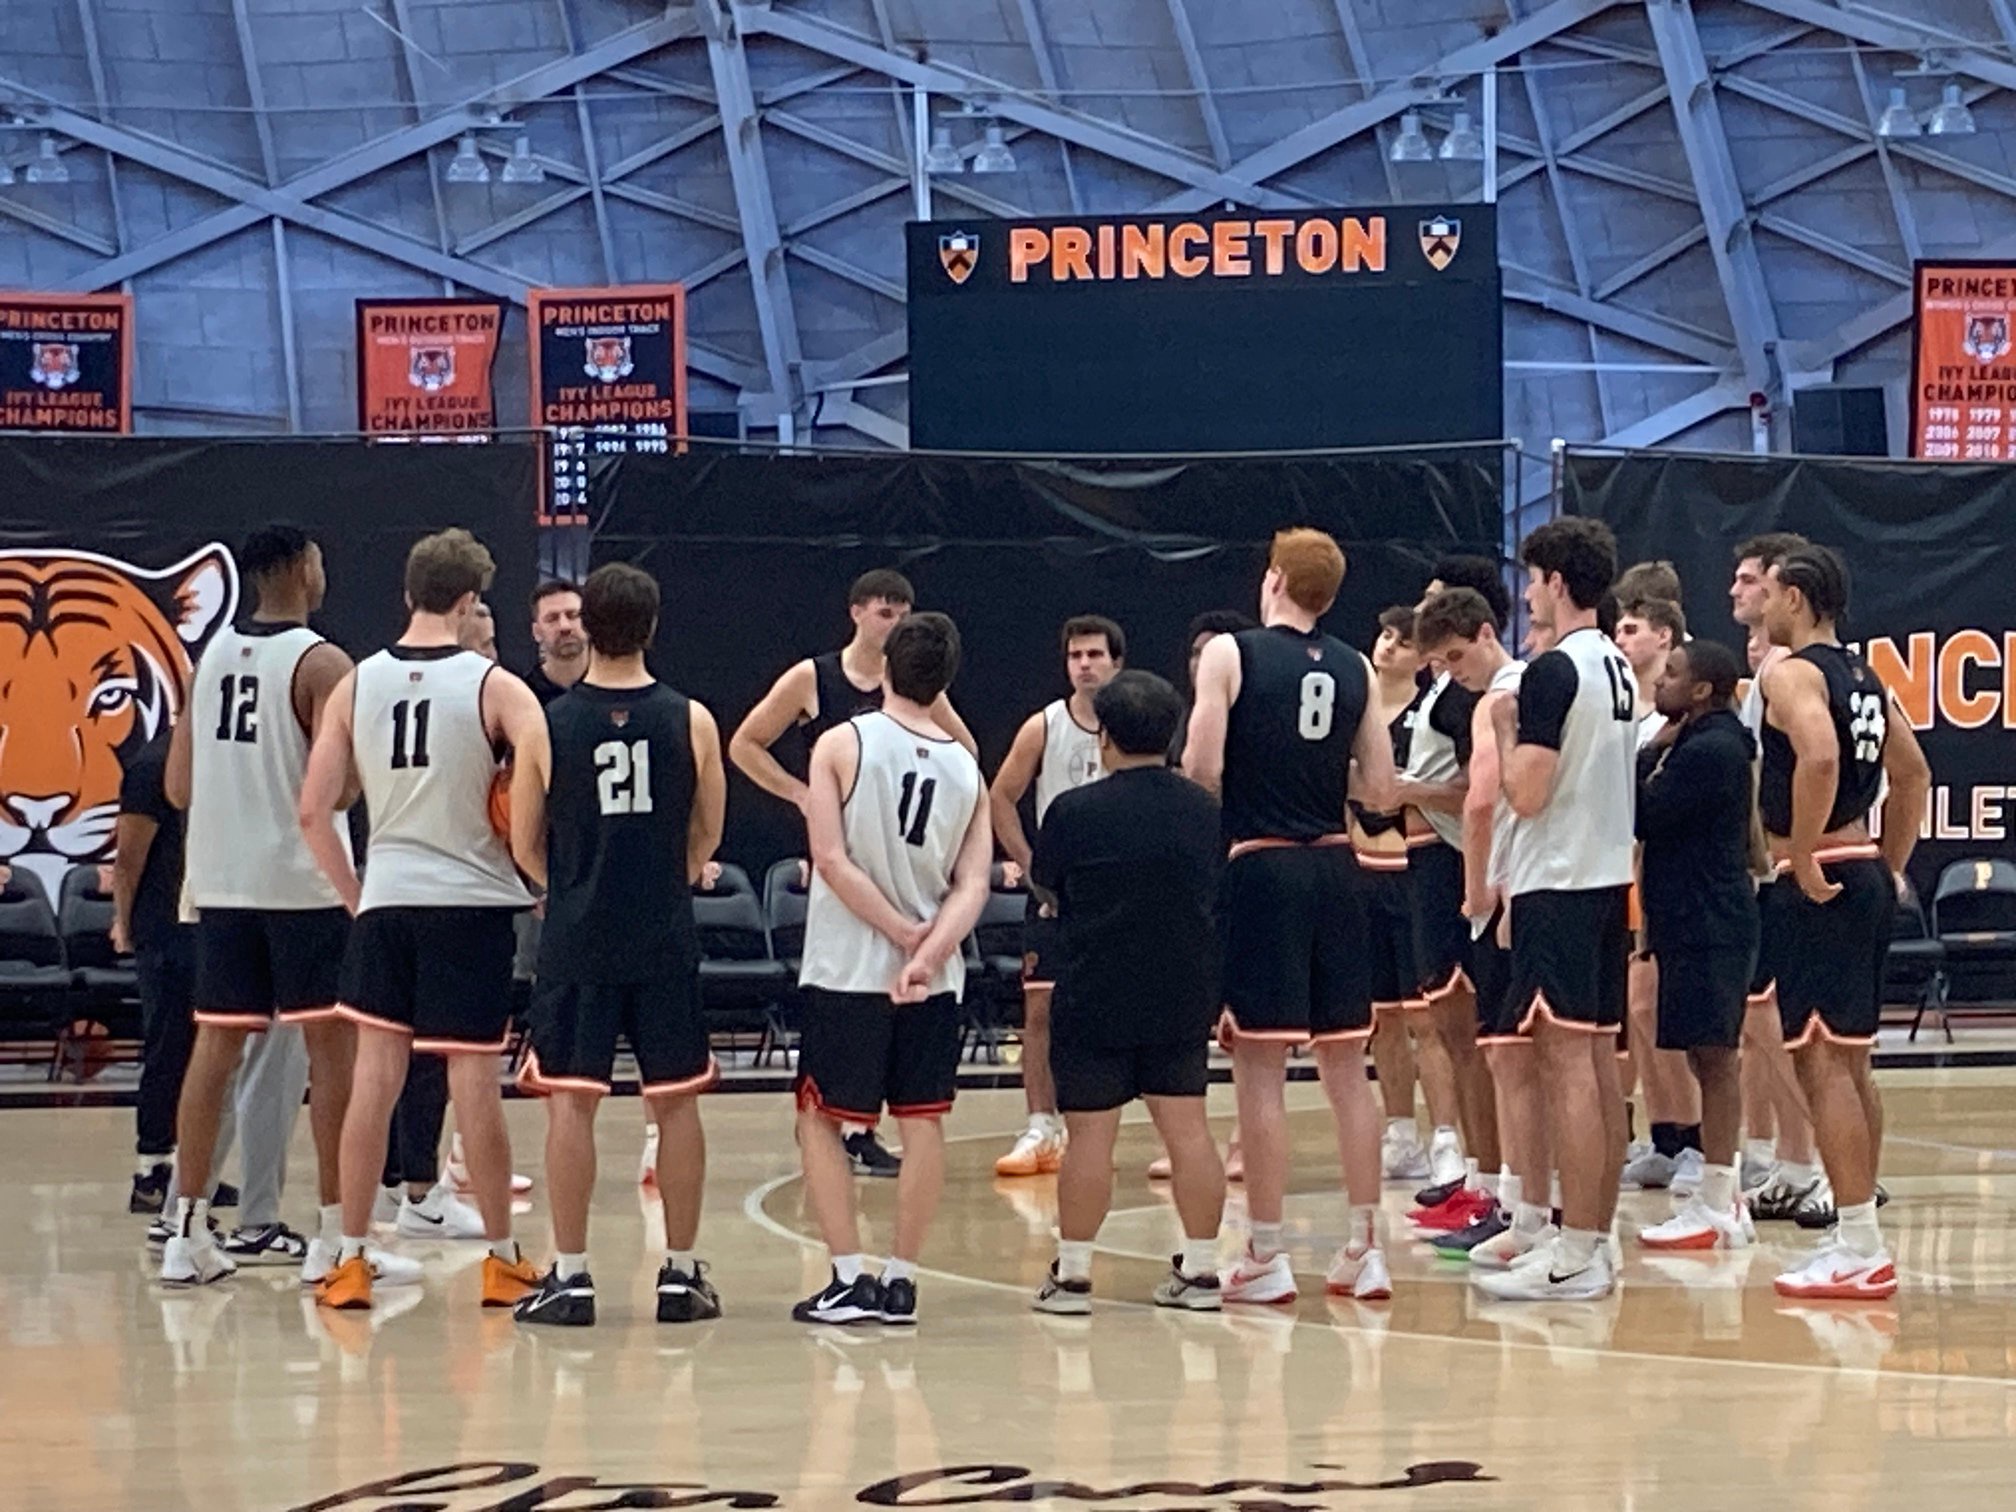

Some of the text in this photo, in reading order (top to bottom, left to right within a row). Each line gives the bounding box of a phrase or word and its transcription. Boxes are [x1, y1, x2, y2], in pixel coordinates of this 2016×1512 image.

[1010, 216, 1386, 282] PRINCETON
[371, 313, 495, 332] PRINCETON
[544, 303, 669, 324] PRINCETON
[1939, 366, 1963, 380] IVY
[39, 392, 102, 406] LEAGUE
[561, 384, 657, 400] IVY LEAGUE
[384, 396, 481, 411] IVY LEAGUE
[546, 400, 672, 420] CHAMPIONS
[371, 413, 490, 431] CHAMPIONS
[1603, 654, 1634, 722] 15
[215, 673, 258, 744] 12
[1299, 671, 1335, 741] 8
[390, 698, 431, 770] 11
[594, 740, 653, 816] 21
[898, 770, 937, 846] 11
